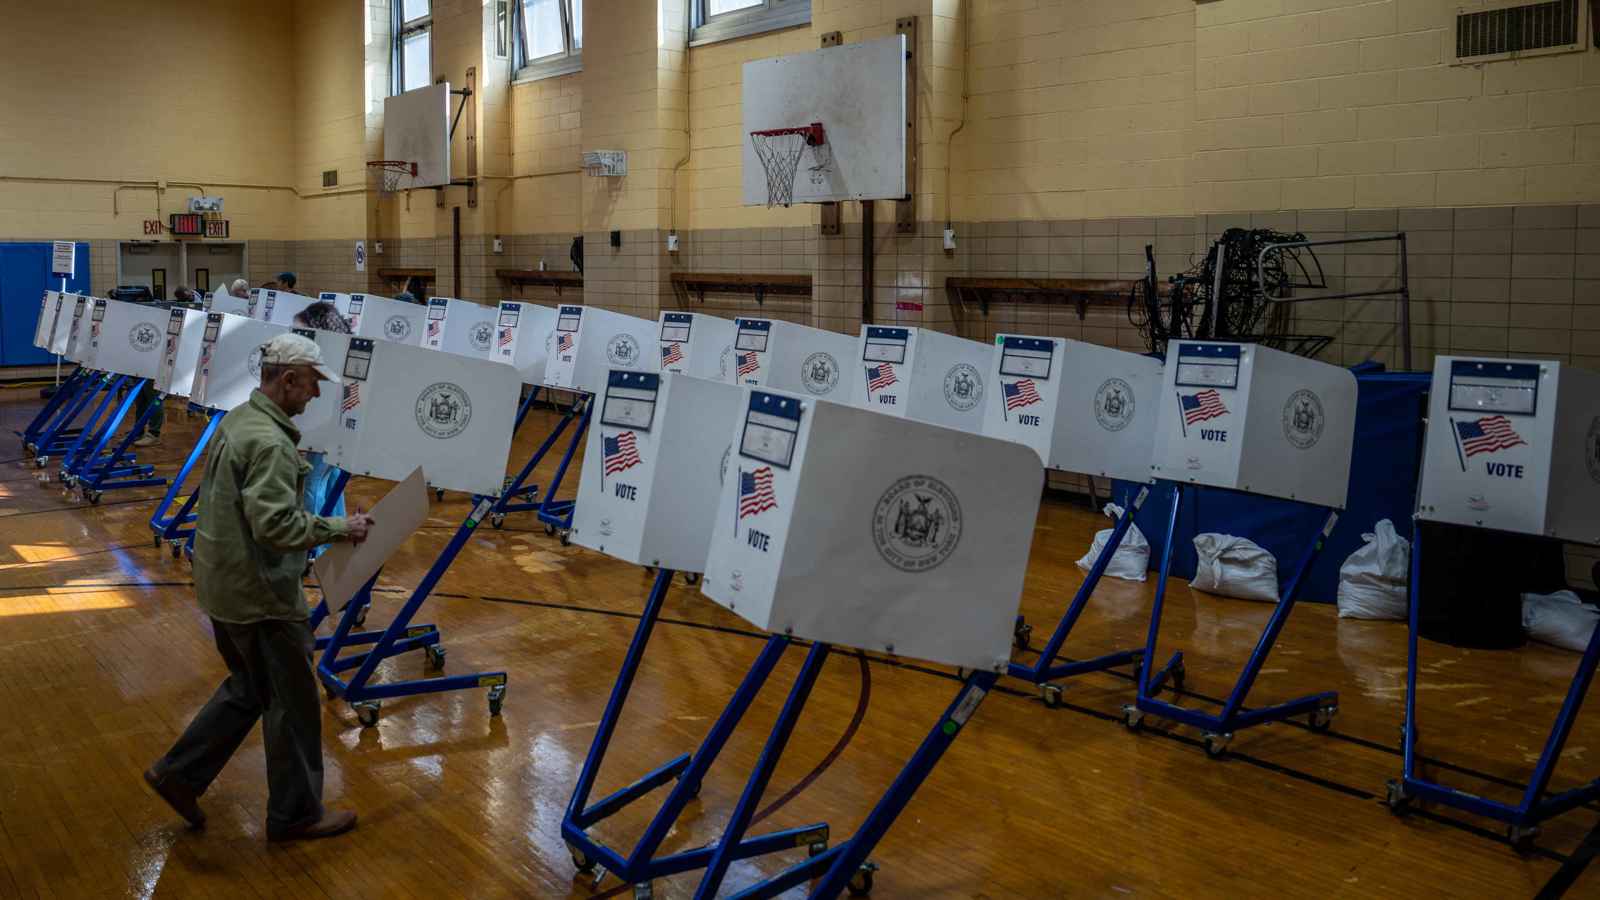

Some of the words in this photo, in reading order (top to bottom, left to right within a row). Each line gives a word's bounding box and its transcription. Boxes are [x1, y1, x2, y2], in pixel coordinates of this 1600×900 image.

[144, 220, 161, 235] EXIT
[208, 222, 224, 236] EXIT
[879, 394, 897, 405] VOTE
[1018, 414, 1041, 426] VOTE
[1200, 429, 1228, 442] VOTE
[1486, 461, 1524, 479] VOTE
[615, 482, 637, 501] VOTE
[748, 527, 770, 552] VOTE
